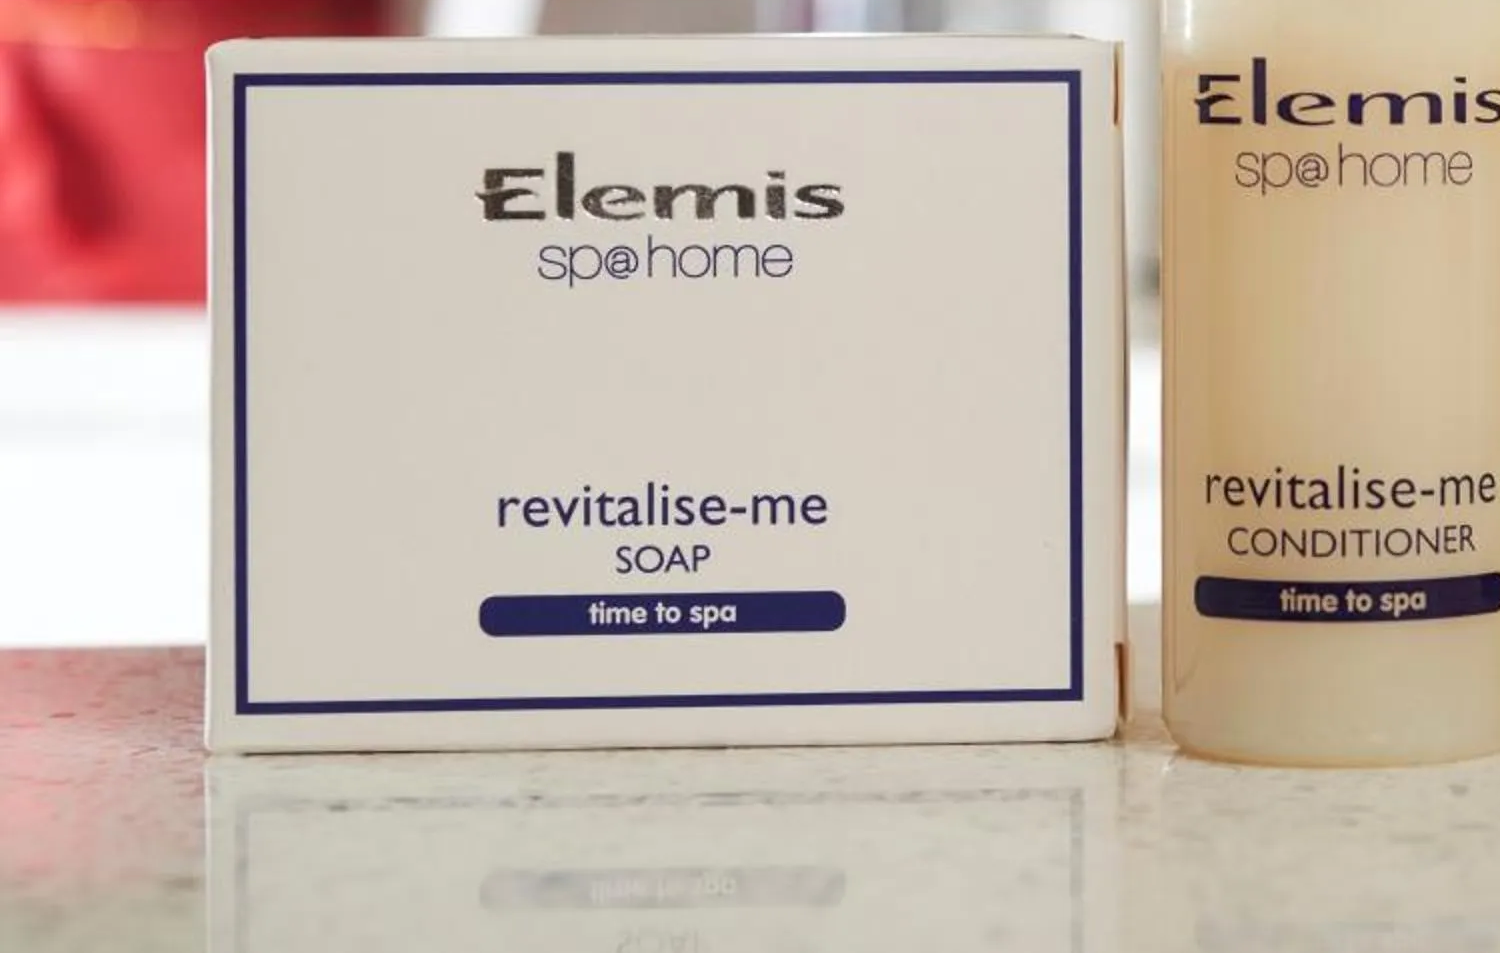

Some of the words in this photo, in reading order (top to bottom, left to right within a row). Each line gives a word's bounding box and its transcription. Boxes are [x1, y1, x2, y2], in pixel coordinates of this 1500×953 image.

[475, 150, 845, 222] Elemis
[1234, 142, 1473, 196] sp@home
[537, 234, 794, 288] sp@home
[498, 481, 828, 528] revitalise-me
[1206, 465, 1496, 510] revitalise-me
[615, 544, 711, 575] SOAP
[1227, 524, 1475, 558] CONDITIONER
[588, 600, 648, 625] time
[654, 601, 682, 624] to
[688, 603, 739, 628] spa
[1279, 587, 1339, 613] time
[1345, 589, 1373, 613] to
[1379, 591, 1427, 618] spa
